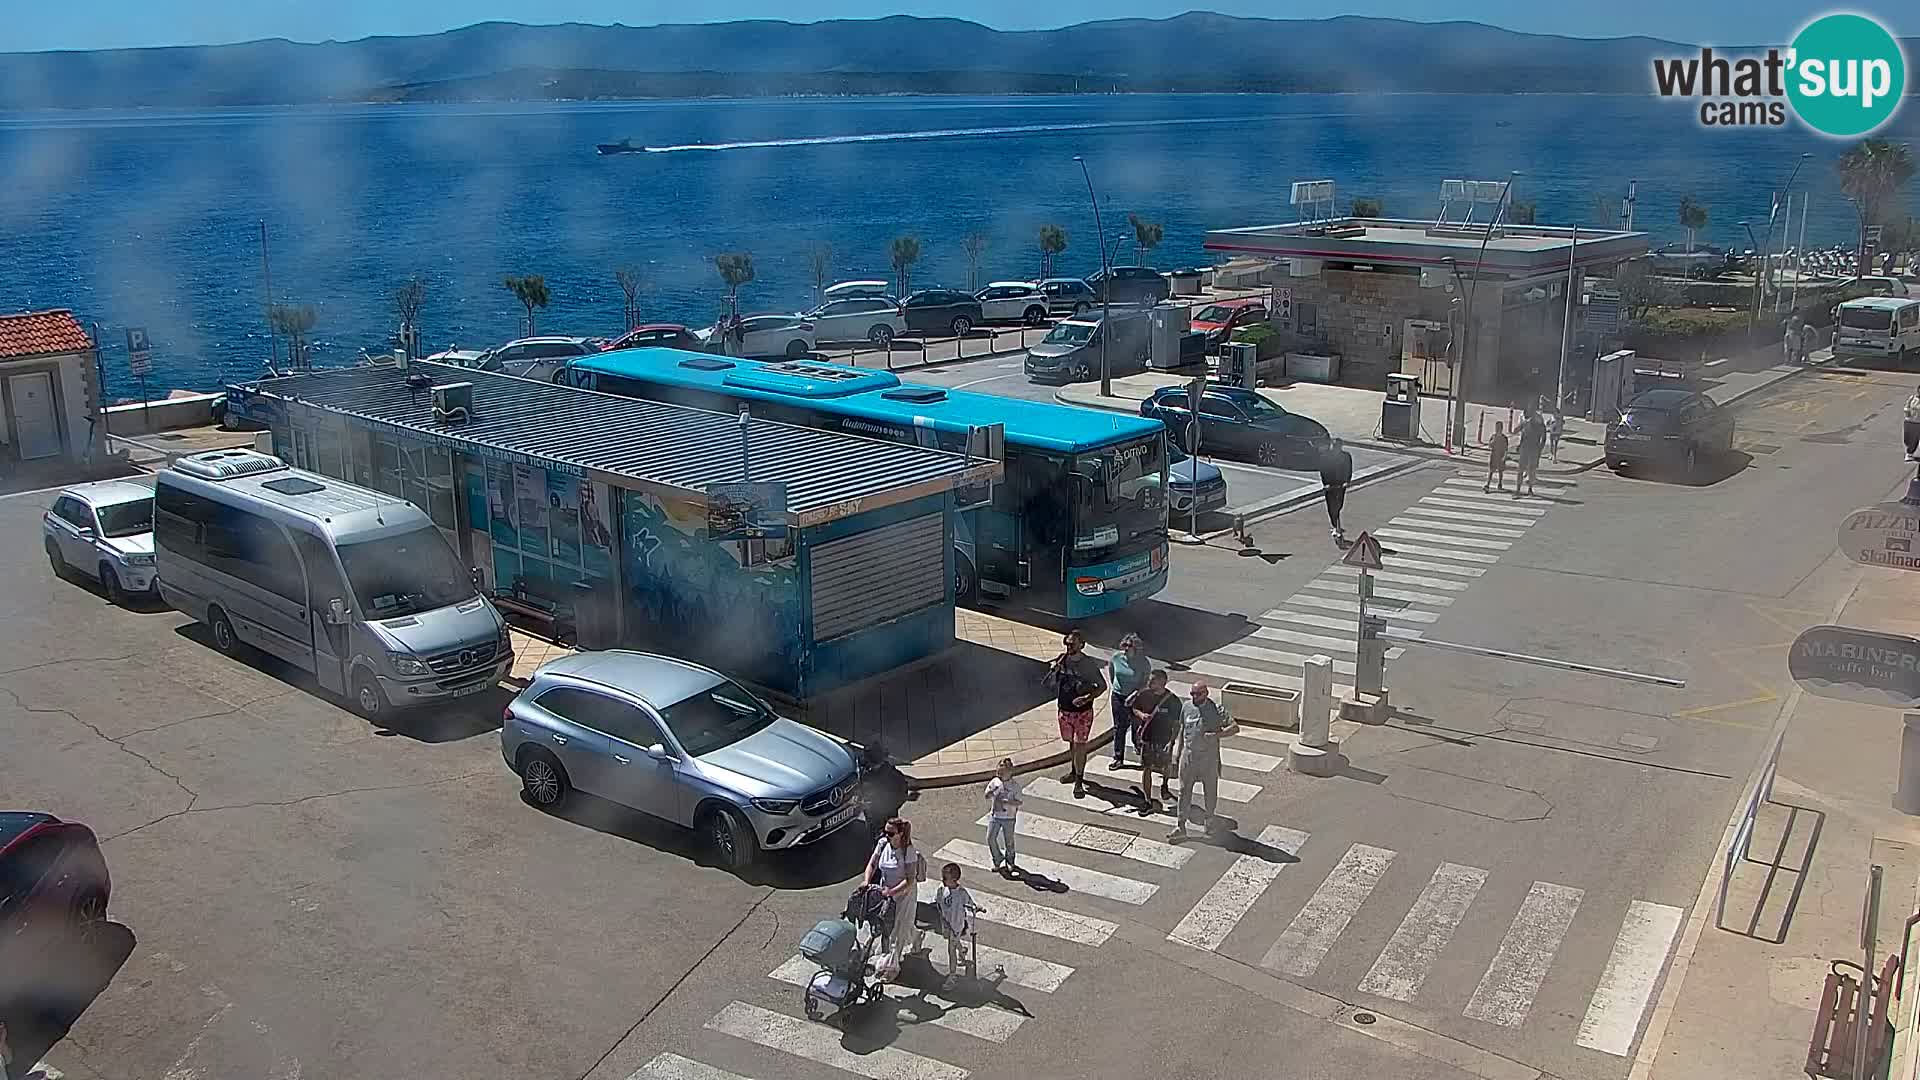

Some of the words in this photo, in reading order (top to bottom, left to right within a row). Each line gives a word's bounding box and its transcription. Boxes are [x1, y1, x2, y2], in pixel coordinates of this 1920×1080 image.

[131, 330, 144, 349] P
[495, 449, 527, 463] STATION
[529, 456, 555, 470] TICKET
[556, 462, 583, 476] OFFICE
[1849, 512, 1920, 532] PIZZE
[1801, 640, 1920, 673] MARINER
